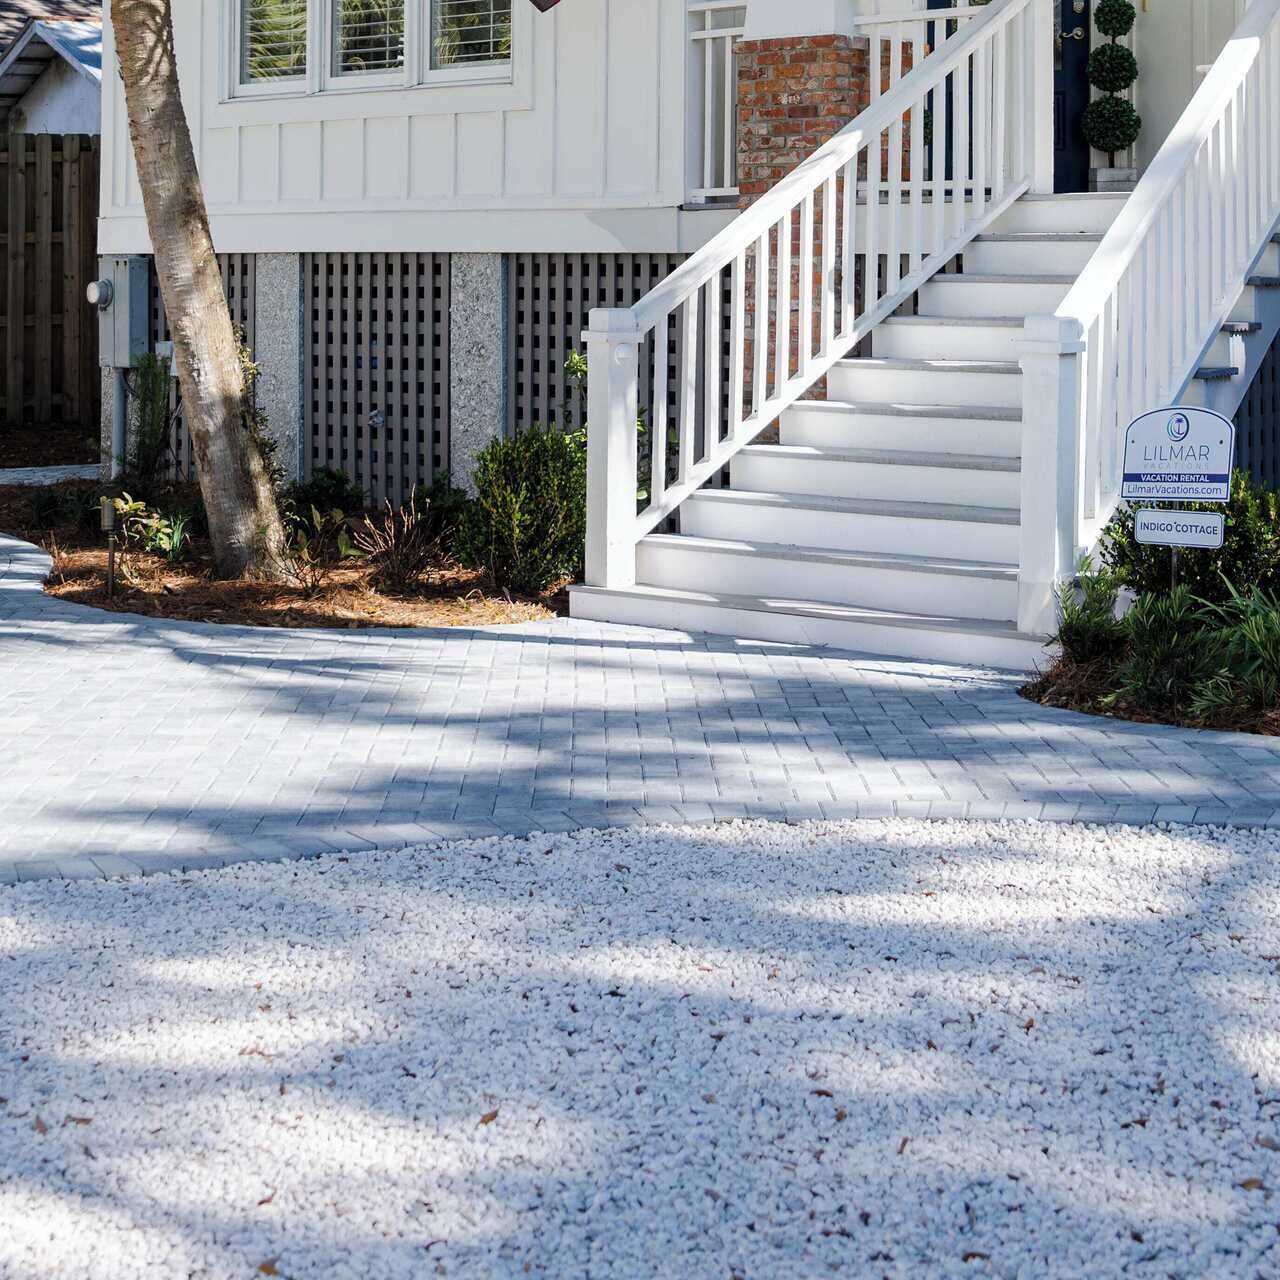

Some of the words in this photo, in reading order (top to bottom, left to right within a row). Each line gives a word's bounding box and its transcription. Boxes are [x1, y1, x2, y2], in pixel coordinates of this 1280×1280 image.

[1143, 444, 1210, 461] LILMAR
[1141, 474, 1179, 482] VACATION
[1180, 474, 1209, 482] RENTAL
[1127, 484, 1222, 495] LilmarVacations.com
[1140, 522, 1173, 532] INDIGO
[1175, 524, 1218, 535] COTTAGE
